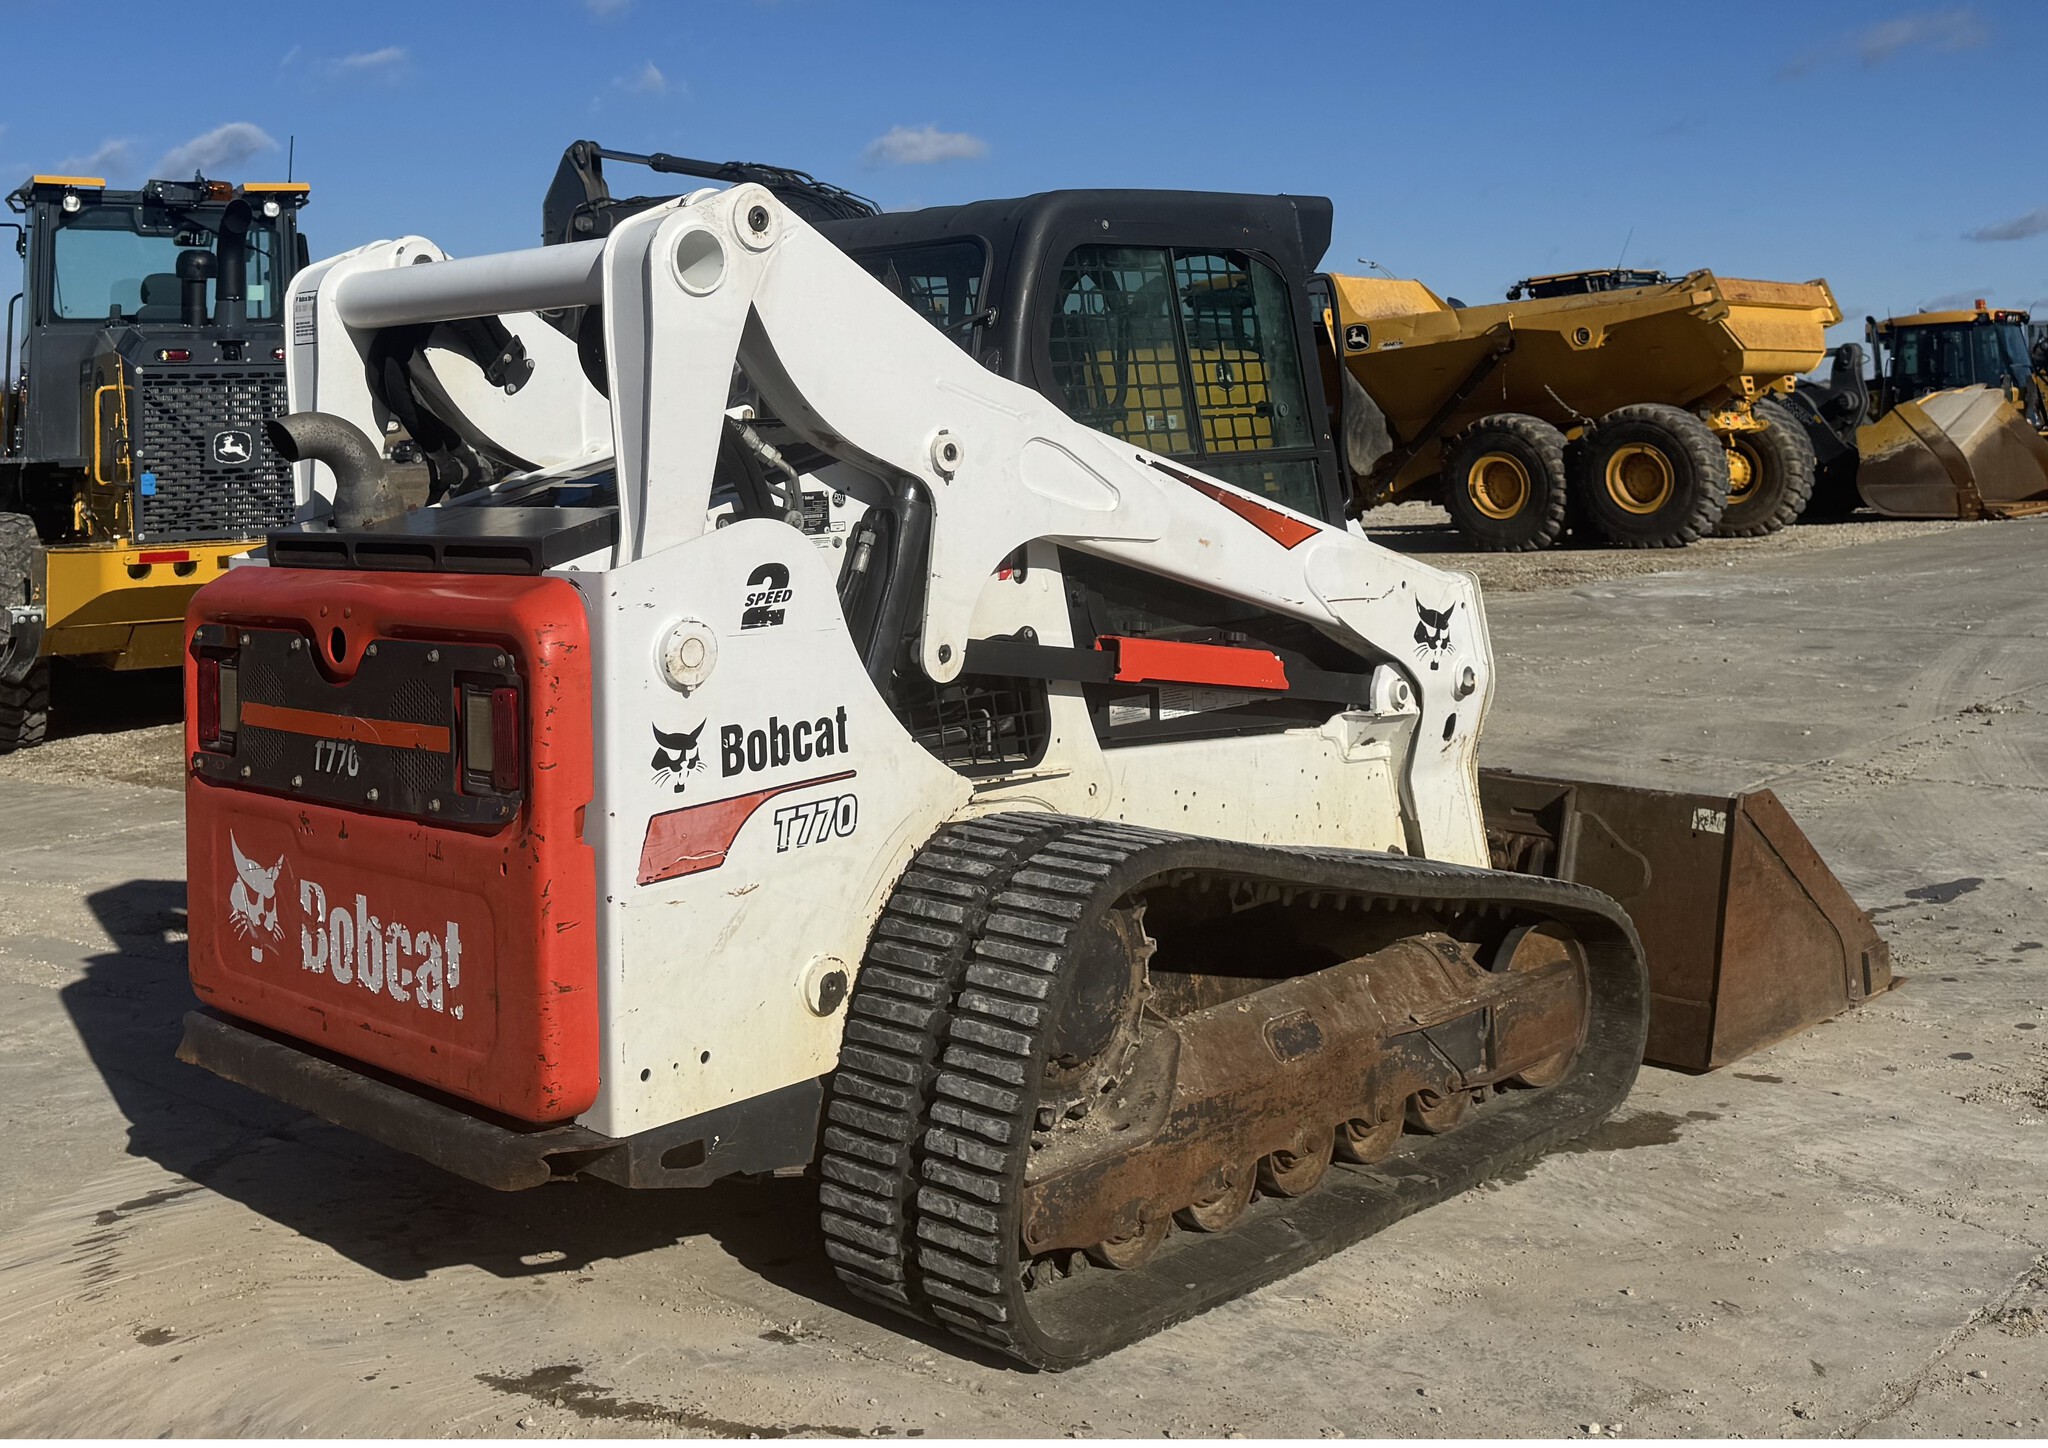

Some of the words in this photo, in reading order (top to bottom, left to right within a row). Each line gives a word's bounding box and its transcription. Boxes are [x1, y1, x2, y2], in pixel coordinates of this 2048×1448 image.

[741, 563, 790, 630] 2
[745, 589, 793, 607] SPEED
[315, 740, 360, 777] T770
[720, 705, 849, 778] Bobcat
[773, 793, 858, 853] T770
[300, 879, 464, 1021] Bobcat
